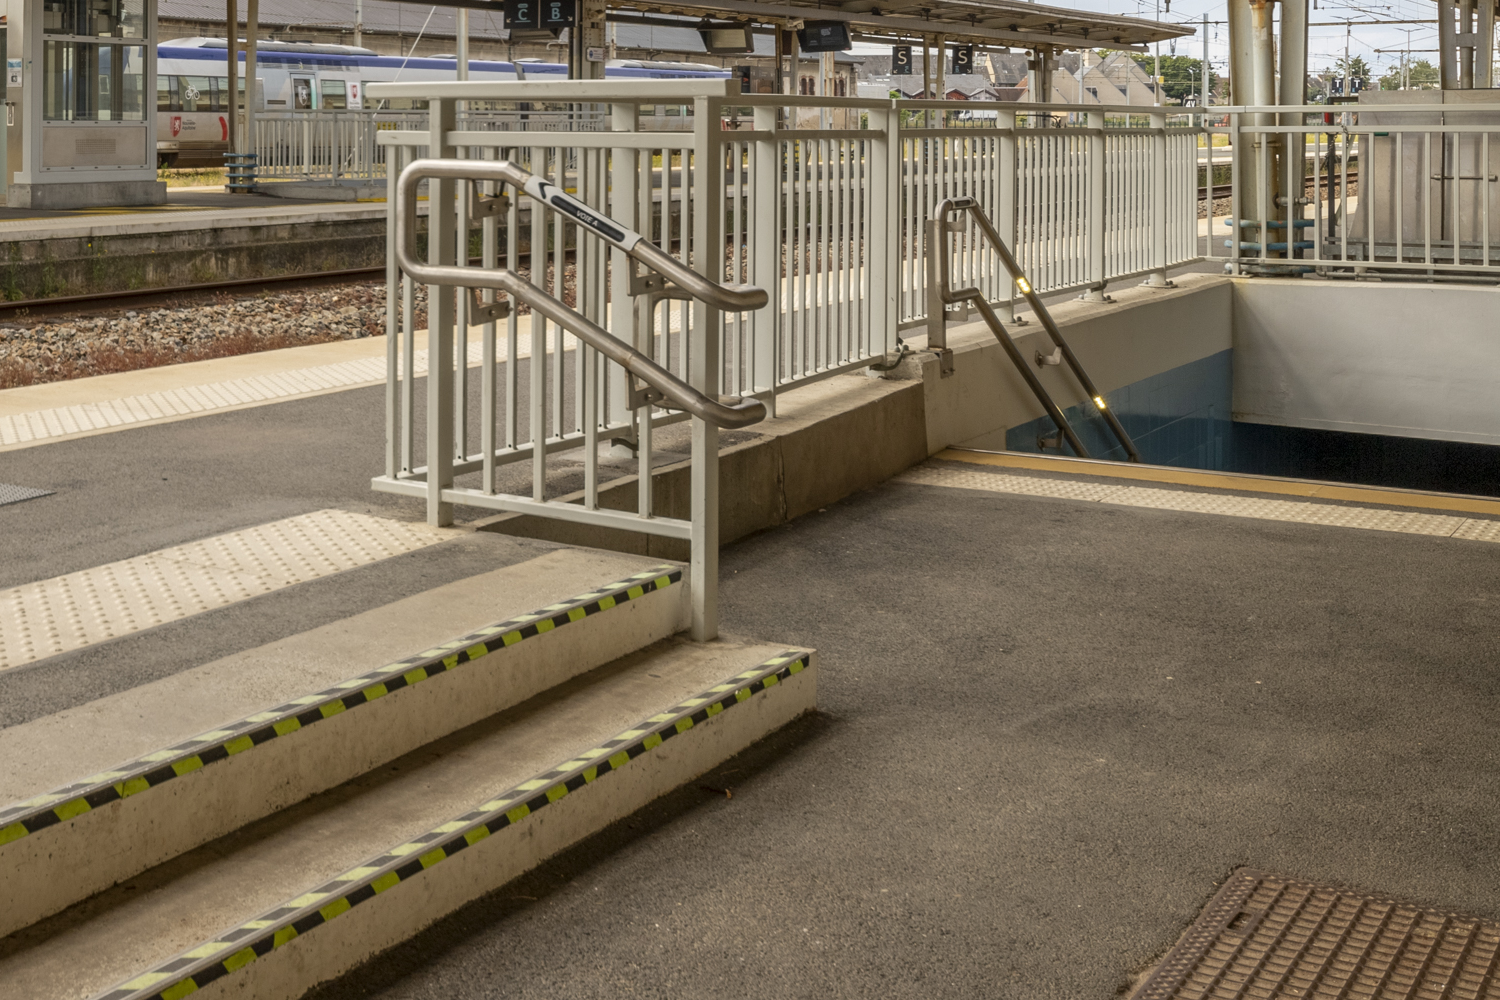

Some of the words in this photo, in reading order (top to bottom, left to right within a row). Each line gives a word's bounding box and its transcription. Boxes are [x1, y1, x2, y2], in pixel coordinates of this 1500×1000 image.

[518, 9, 528, 20] C
[551, 8, 560, 19] B
[897, 51, 907, 64] S
[958, 50, 968, 64] S
[1334, 80, 1341, 88] T
[1353, 80, 1360, 88] T
[576, 210, 594, 223] VOIE
